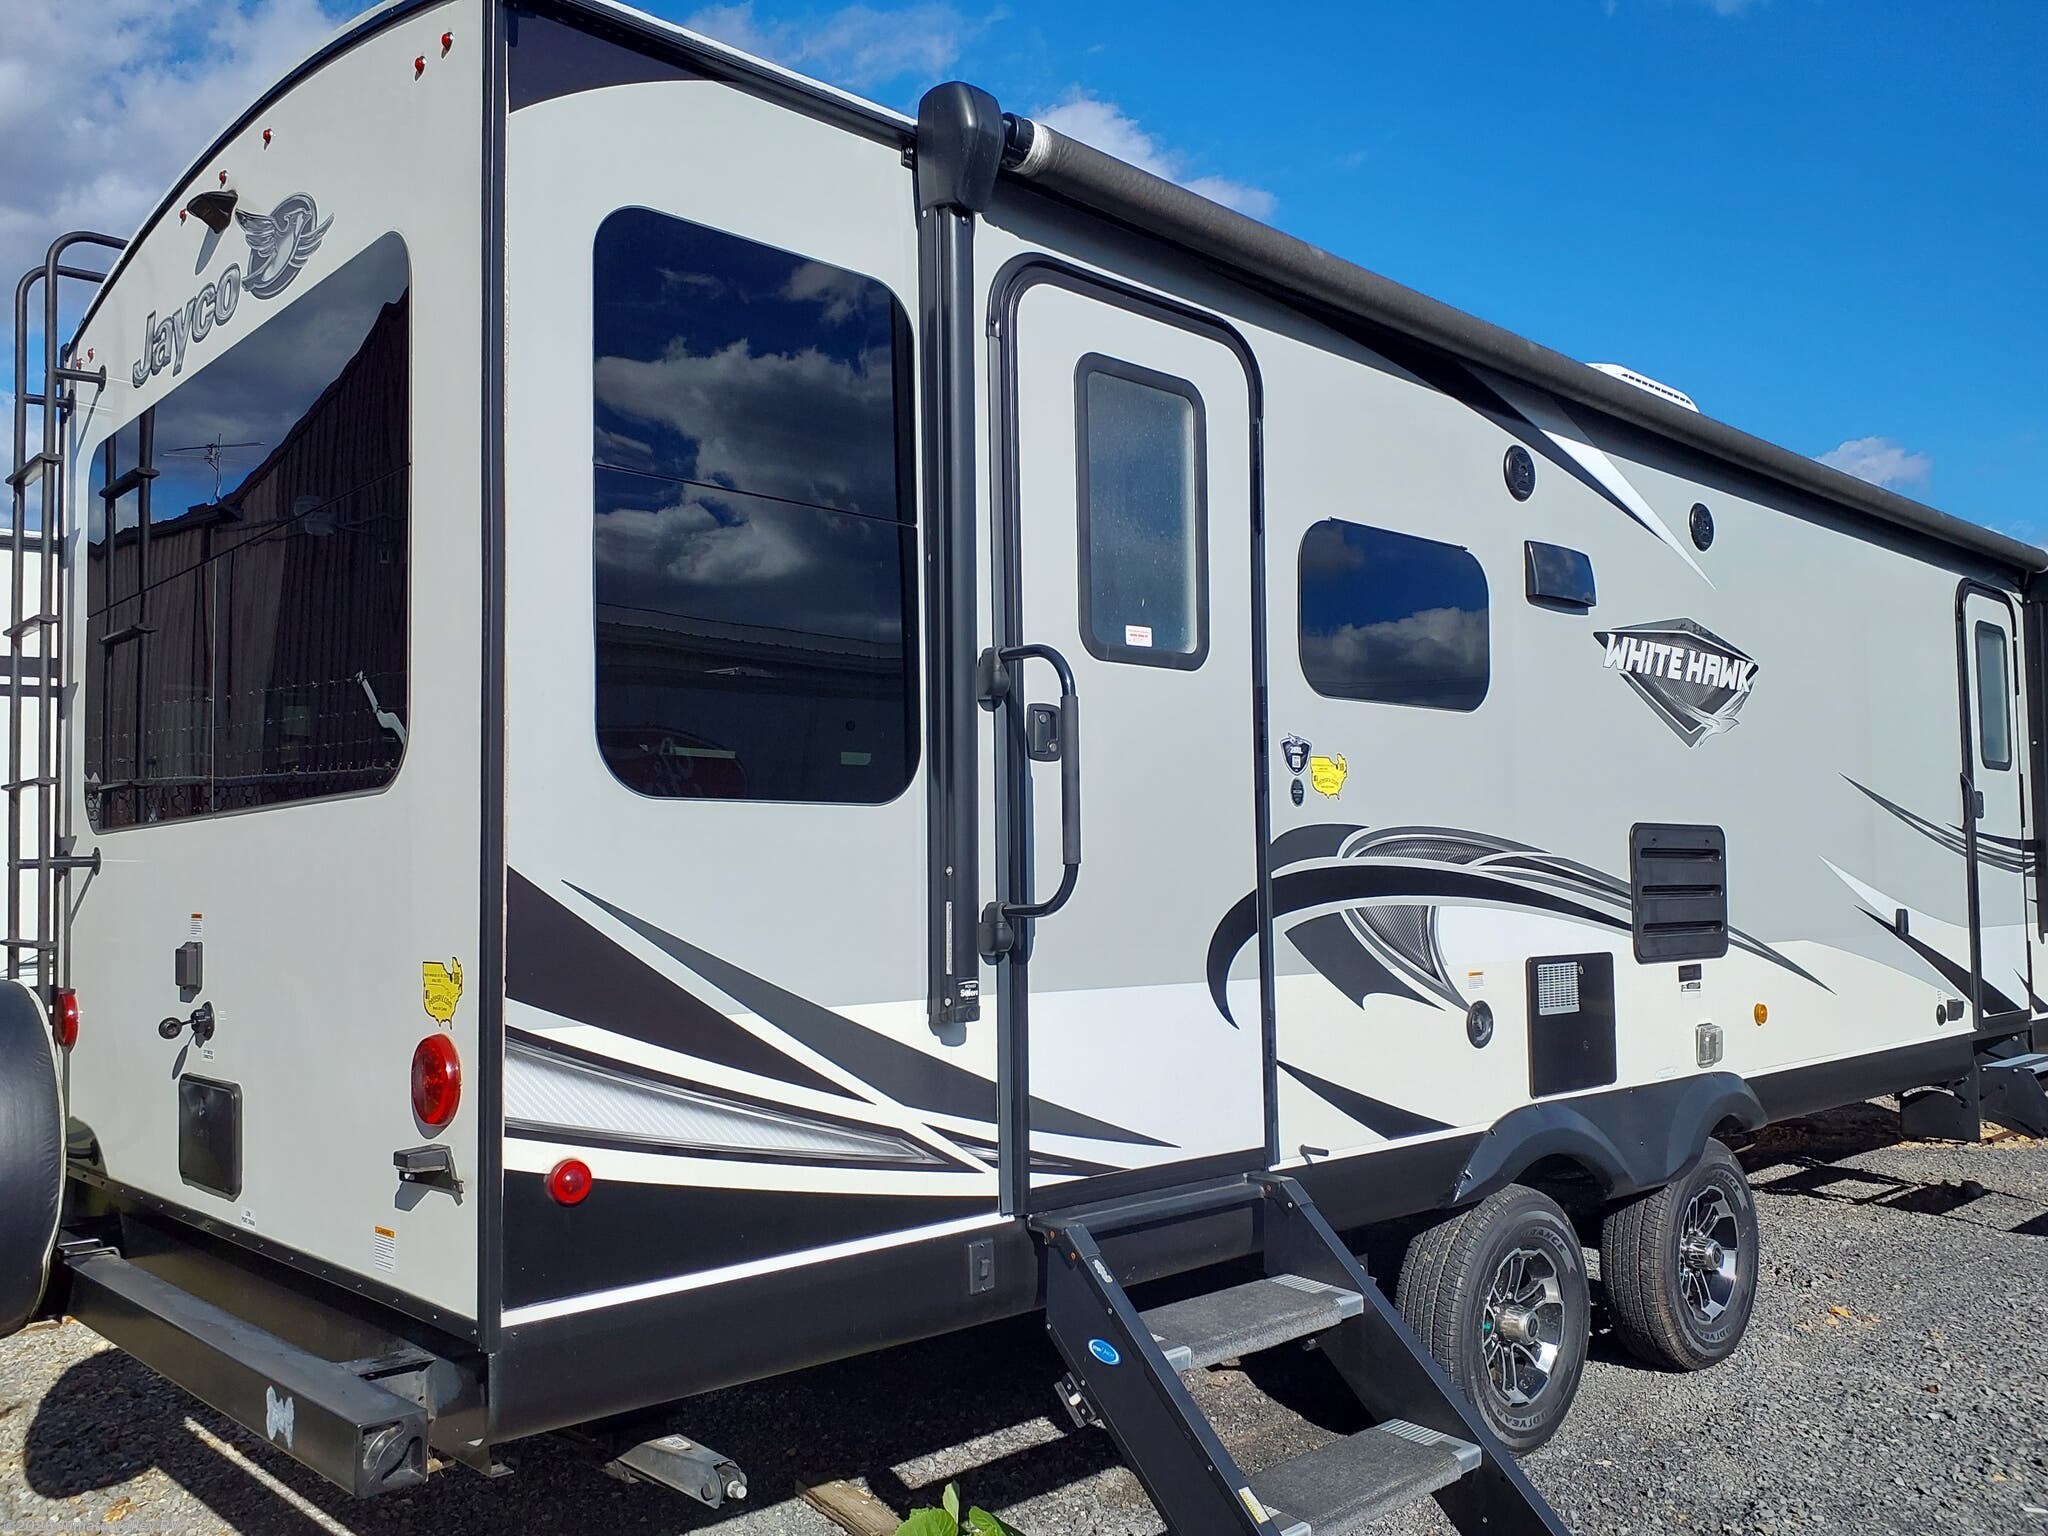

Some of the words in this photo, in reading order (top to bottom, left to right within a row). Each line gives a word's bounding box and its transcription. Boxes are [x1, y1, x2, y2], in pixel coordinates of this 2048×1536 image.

[132, 262, 241, 389] Jayco
[1603, 633, 1685, 681] WHITE
[1685, 650, 1754, 693] HAWK
